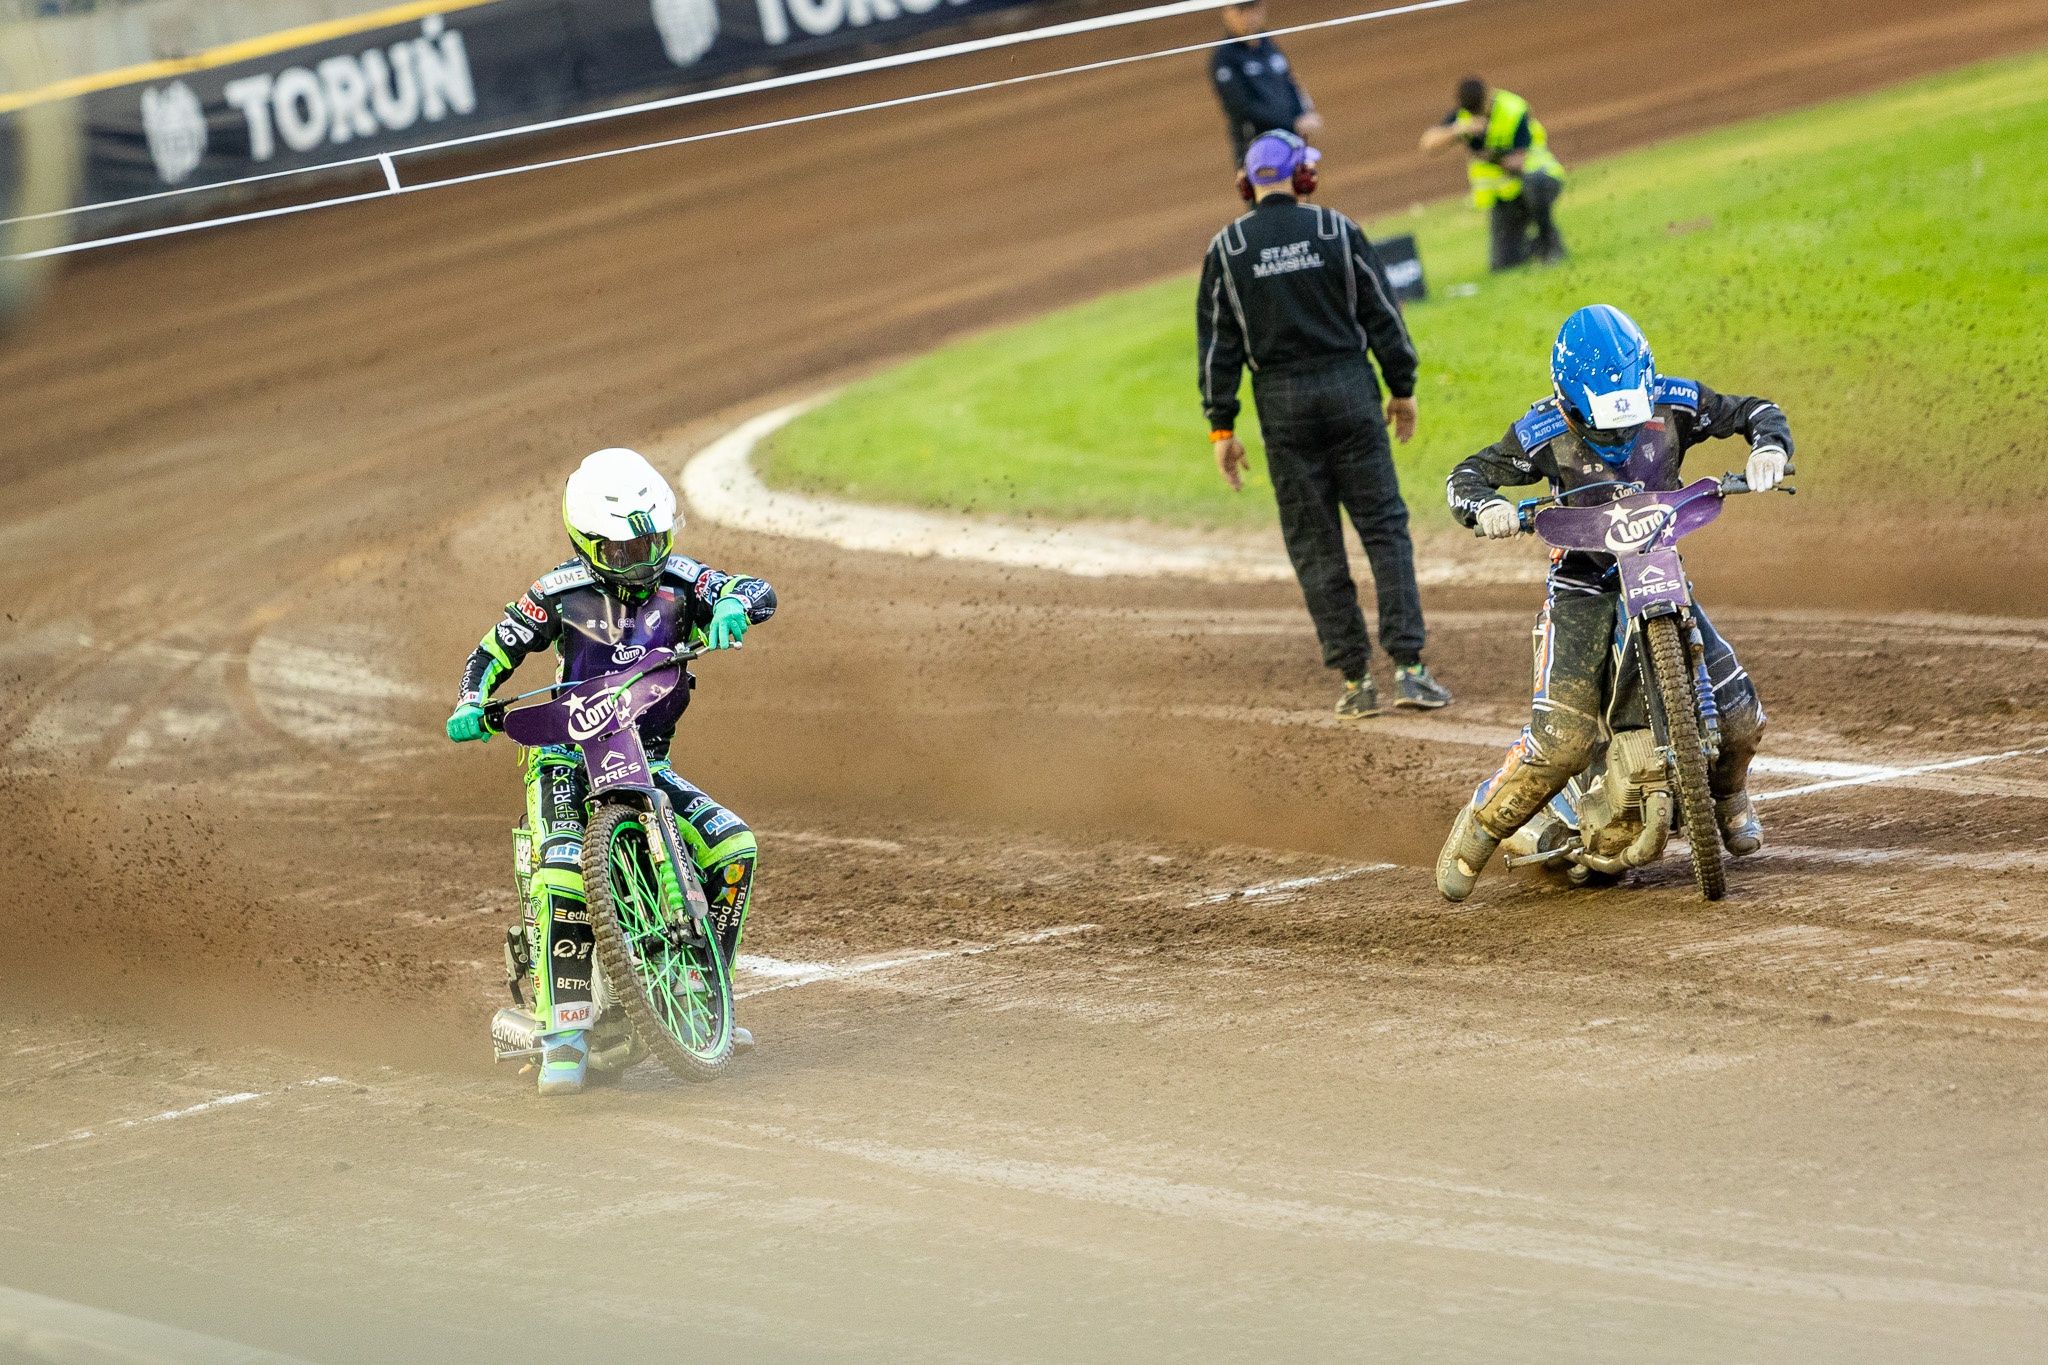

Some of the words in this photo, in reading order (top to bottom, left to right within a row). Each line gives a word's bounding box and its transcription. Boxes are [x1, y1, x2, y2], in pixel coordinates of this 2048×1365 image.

[223, 17, 477, 162] TORUŃ
[1260, 240, 1310, 262] START
[1252, 252, 1325, 278] MARSHAL
[1668, 386, 1698, 401] AUTO
[1535, 424, 1552, 438] AUTO
[1616, 512, 1664, 542] LOTTO
[667, 558, 694, 578] MEL
[1629, 580, 1681, 599] PRES
[618, 648, 640, 661] LOTTO
[575, 694, 619, 731] LOTTO
[593, 761, 641, 788] PRES
